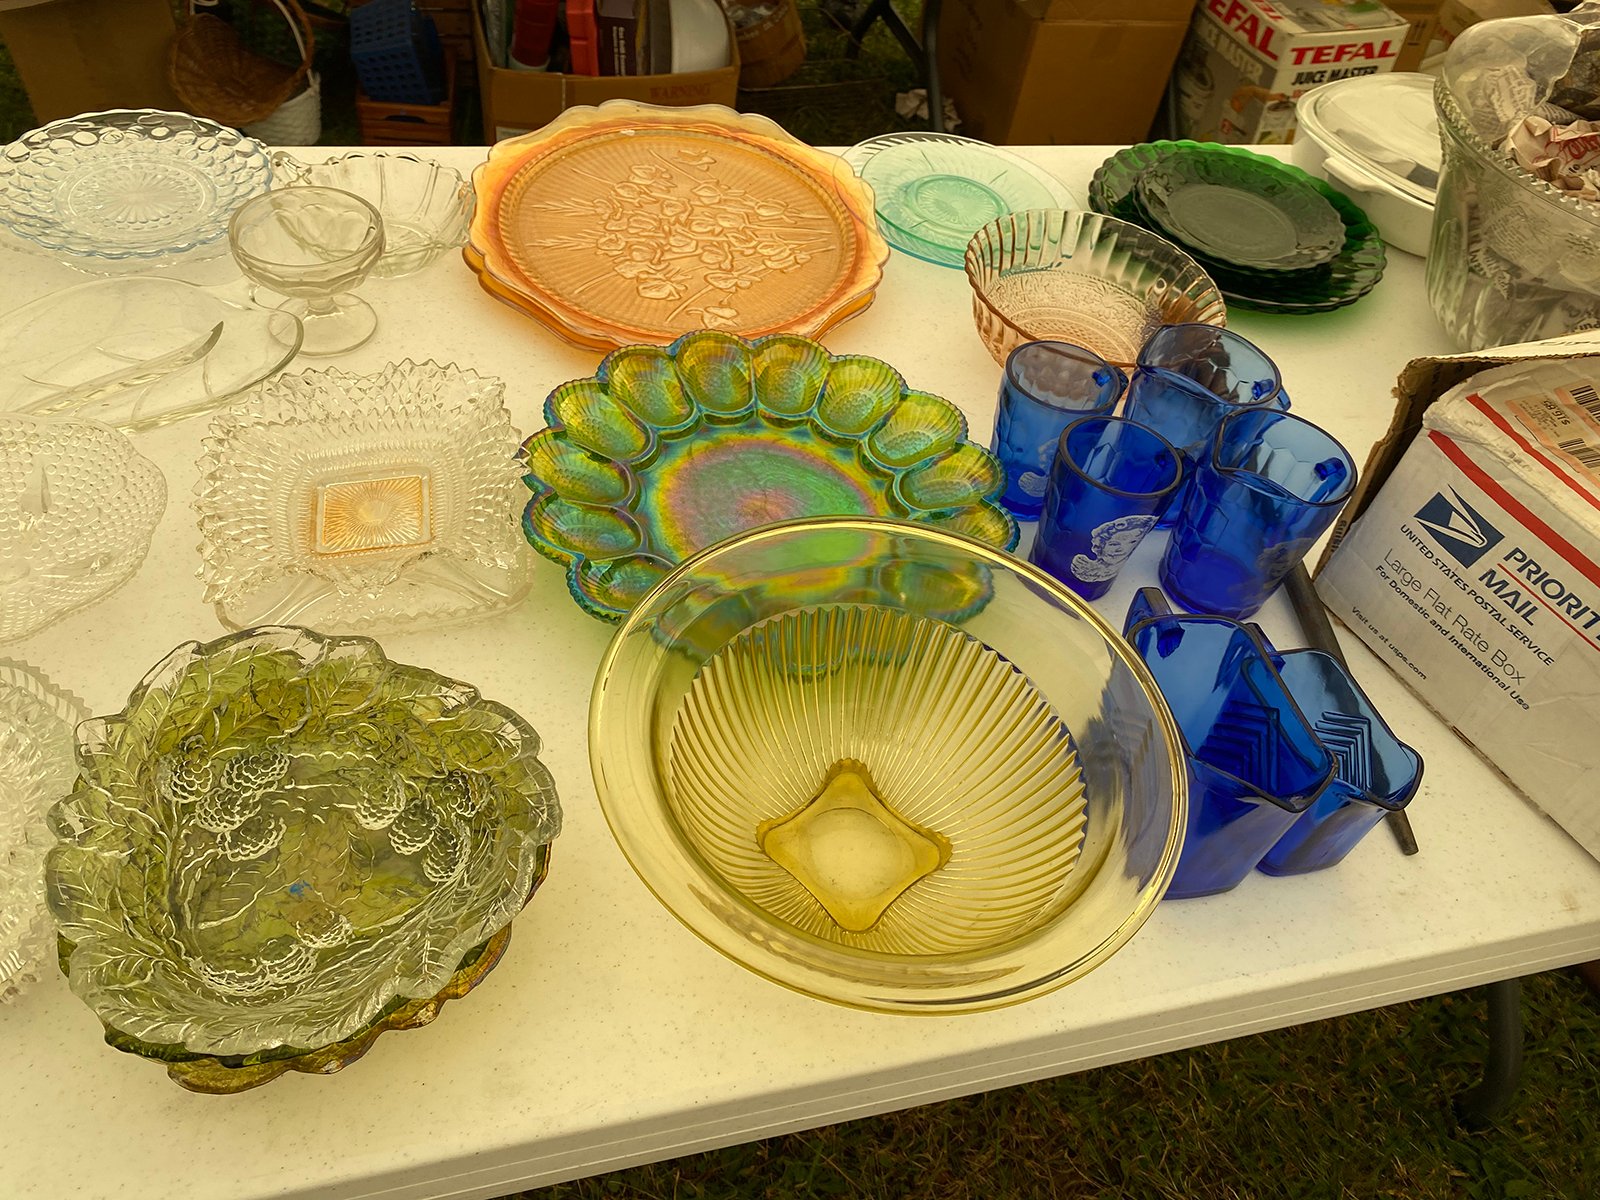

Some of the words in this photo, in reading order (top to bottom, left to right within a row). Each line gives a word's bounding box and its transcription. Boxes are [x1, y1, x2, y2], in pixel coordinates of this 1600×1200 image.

[1208, 0, 1279, 61] EFAL
[1290, 40, 1396, 66] TEFAL
[651, 83, 711, 98] WARNING
[1291, 70, 1328, 86] JUICE
[1384, 548, 1422, 592] Large
[1423, 588, 1452, 619] Flat
[1452, 614, 1489, 652] Rate
[1491, 649, 1526, 686] Box
[1400, 524, 1434, 559] UNITED
[1432, 558, 1469, 591] STATES
[1467, 589, 1507, 627] POSTAL
[1506, 624, 1554, 666] SERVICE
[1478, 568, 1538, 627] MAIL
[1503, 547, 1600, 641] PRIORIT
[1352, 607, 1368, 624] Visit
[1368, 624, 1379, 635] us
[1379, 634, 1389, 644] at
[1388, 643, 1427, 680] usps.com
[1376, 565, 1390, 580] For
[1389, 580, 1430, 619] Domestic
[1430, 619, 1450, 636] and
[1449, 635, 1511, 691] International
[1509, 690, 1530, 710] Use
